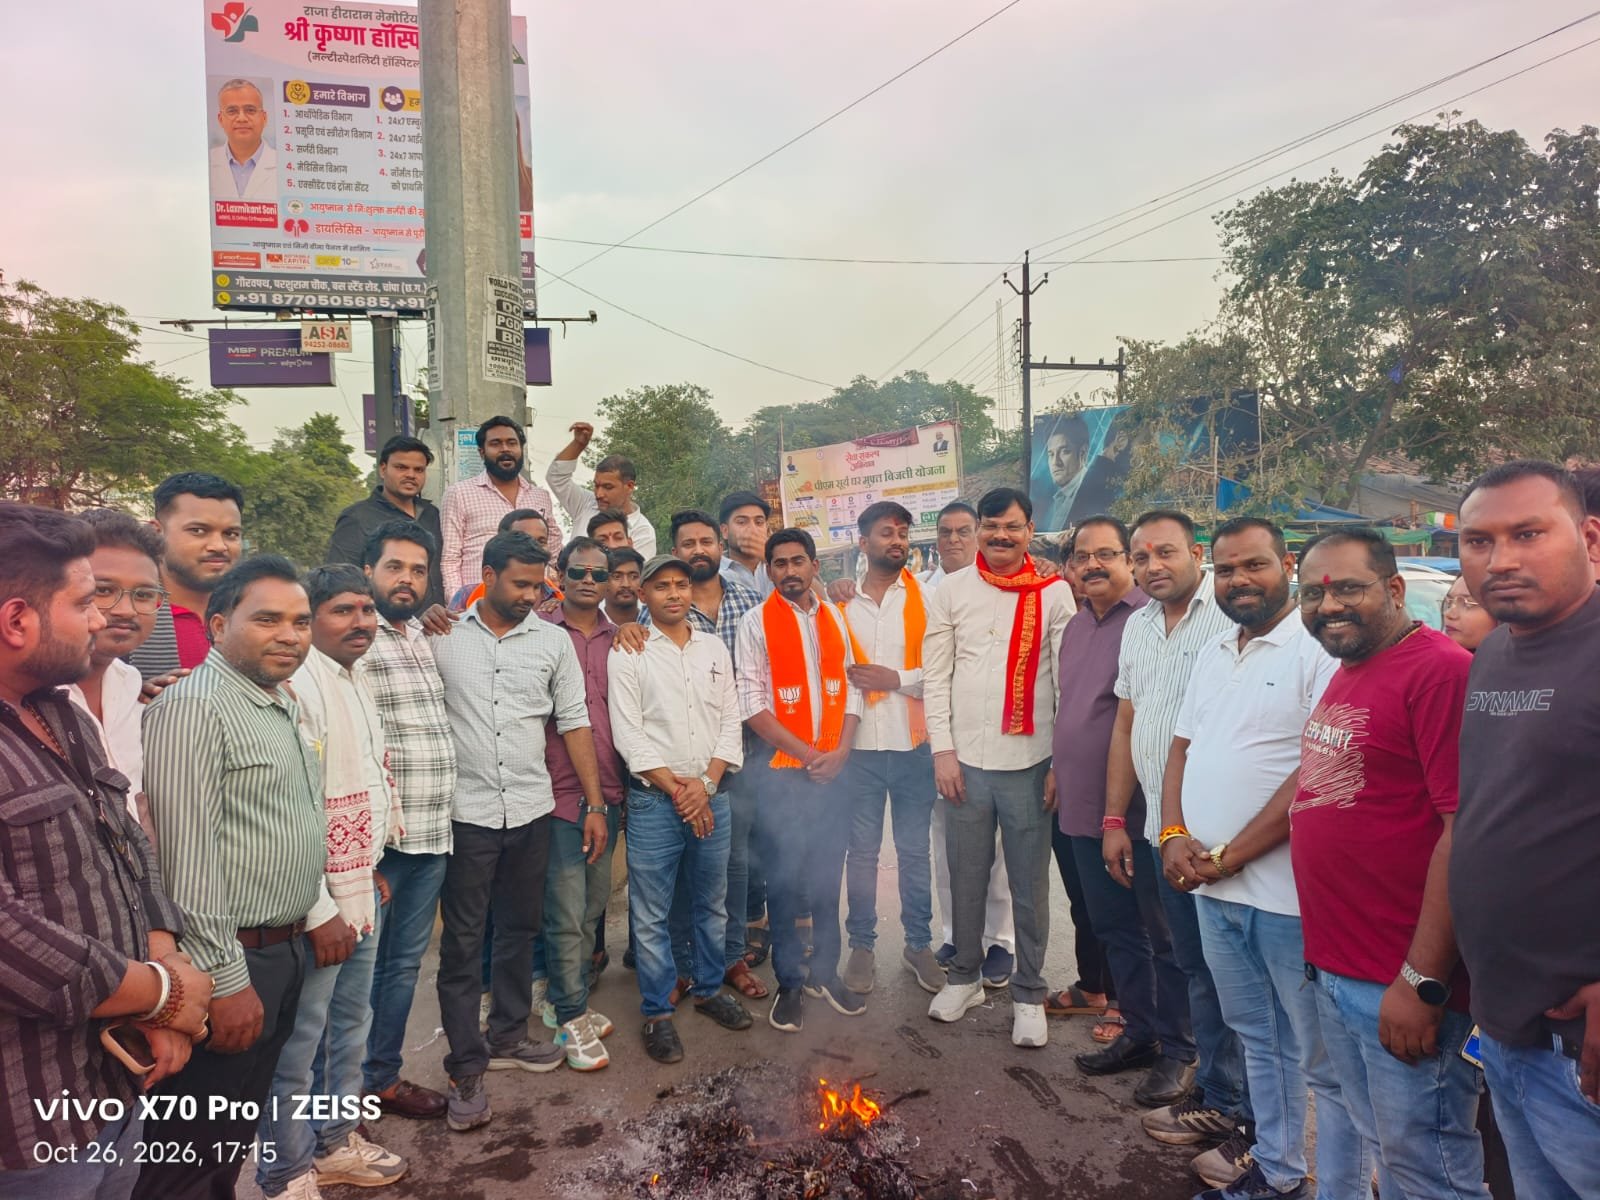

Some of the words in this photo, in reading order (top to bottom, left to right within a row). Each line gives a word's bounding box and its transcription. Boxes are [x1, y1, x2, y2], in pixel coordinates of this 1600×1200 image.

[303, 6, 328, 17] राजा
[331, 5, 373, 20] हीराराम
[376, 9, 418, 24] मेमोरिय
[284, 16, 310, 42] श्री
[312, 23, 367, 52] कृष्णा
[369, 22, 419, 50] हॉस्पि
[307, 50, 381, 66] (मल्टीस्पेशलिटी
[312, 88, 338, 101] हमारे
[337, 88, 366, 103] विभाग
[284, 109, 290, 118] 1.
[331, 110, 353, 122] विभाग
[376, 115, 383, 124] 1.
[388, 116, 405, 126] 24x7
[406, 117, 422, 131] एम्बु
[284, 125, 292, 134] 2.
[351, 127, 373, 140] विभाग
[377, 131, 385, 140] 2.
[389, 134, 406, 144] 24x7
[285, 143, 294, 152] 3.
[316, 144, 338, 156] विभाग
[377, 149, 386, 158] 3.
[390, 151, 407, 160] 24x7
[286, 162, 295, 171] 4.
[325, 162, 348, 175] विभाग
[379, 168, 388, 177] 4.
[286, 178, 295, 188] 5.
[391, 180, 401, 190] को
[401, 181, 424, 192] प्राथमि
[216, 202, 226, 213] Dr.
[226, 203, 261, 215] Laxmikant
[310, 202, 344, 214] आयुष्मान
[315, 221, 362, 236] डायलिसिस
[373, 227, 404, 239] आयुष्मान
[273, 279, 309, 292] परशुराम
[311, 278, 330, 292] चौक,
[332, 281, 346, 291] बस
[365, 280, 381, 293] रोड,
[489, 277, 508, 289] WORLD
[237, 293, 267, 304] +91
[814, 479, 834, 491] पीएम
[836, 479, 849, 491] सूर्य
[850, 476, 862, 485] घर
[884, 466, 913, 482] बिजली
[915, 464, 946, 478] योजना
[1466, 689, 1555, 712] DYNAMIC
